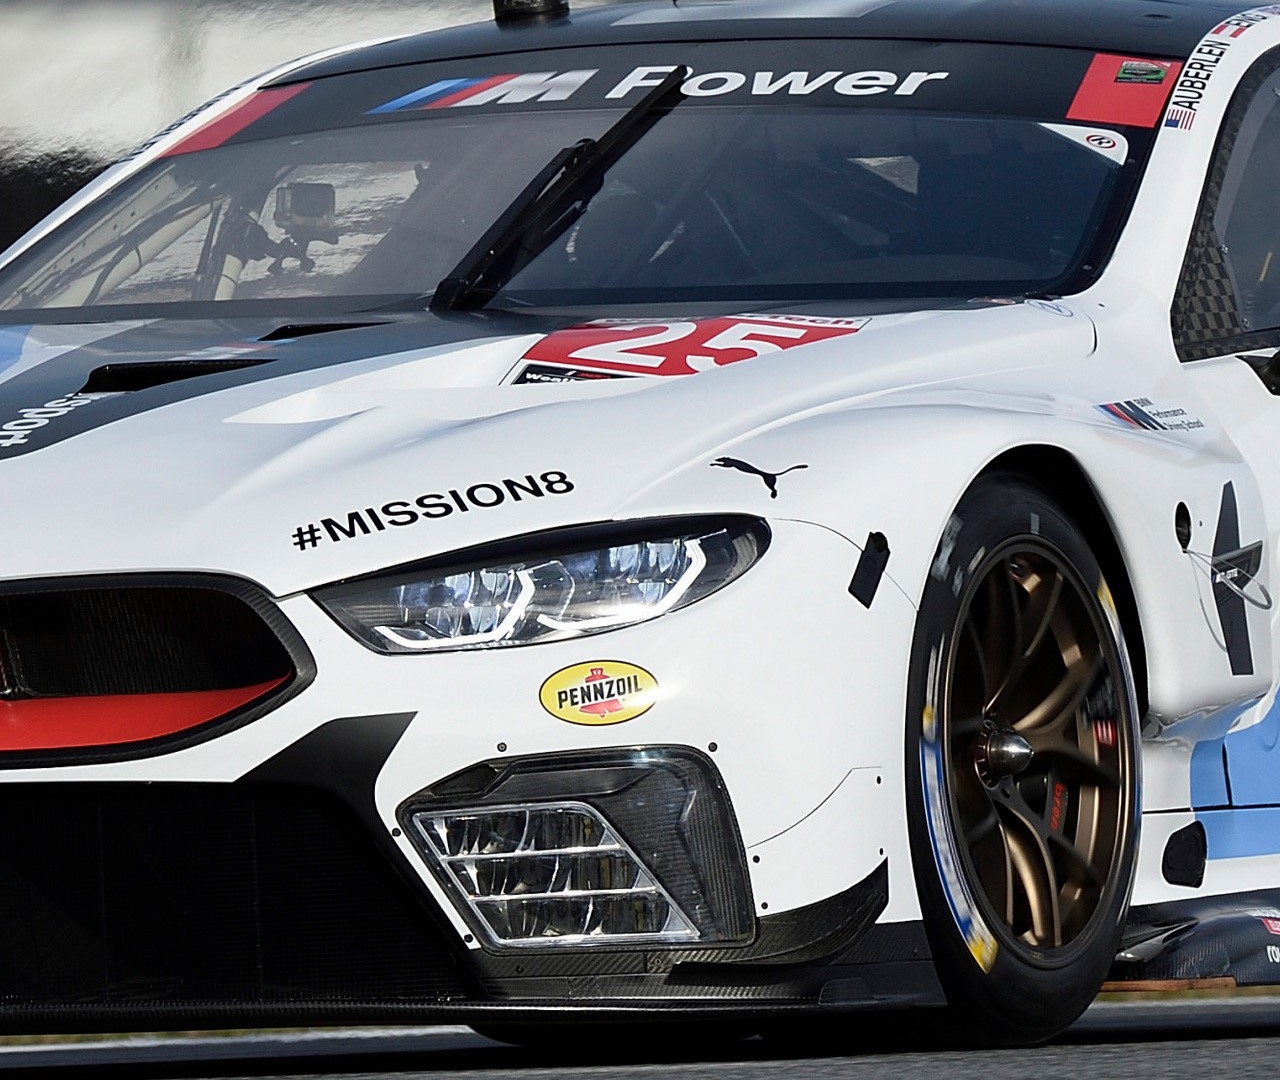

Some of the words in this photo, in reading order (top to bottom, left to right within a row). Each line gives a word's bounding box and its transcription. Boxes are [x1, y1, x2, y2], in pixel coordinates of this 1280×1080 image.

[604, 66, 950, 99] Power
[1172, 39, 1231, 112] AUBERLEN
[566, 321, 810, 374] 25
[291, 470, 576, 552] #MISSION8
[556, 674, 644, 710] PENNZOIL
